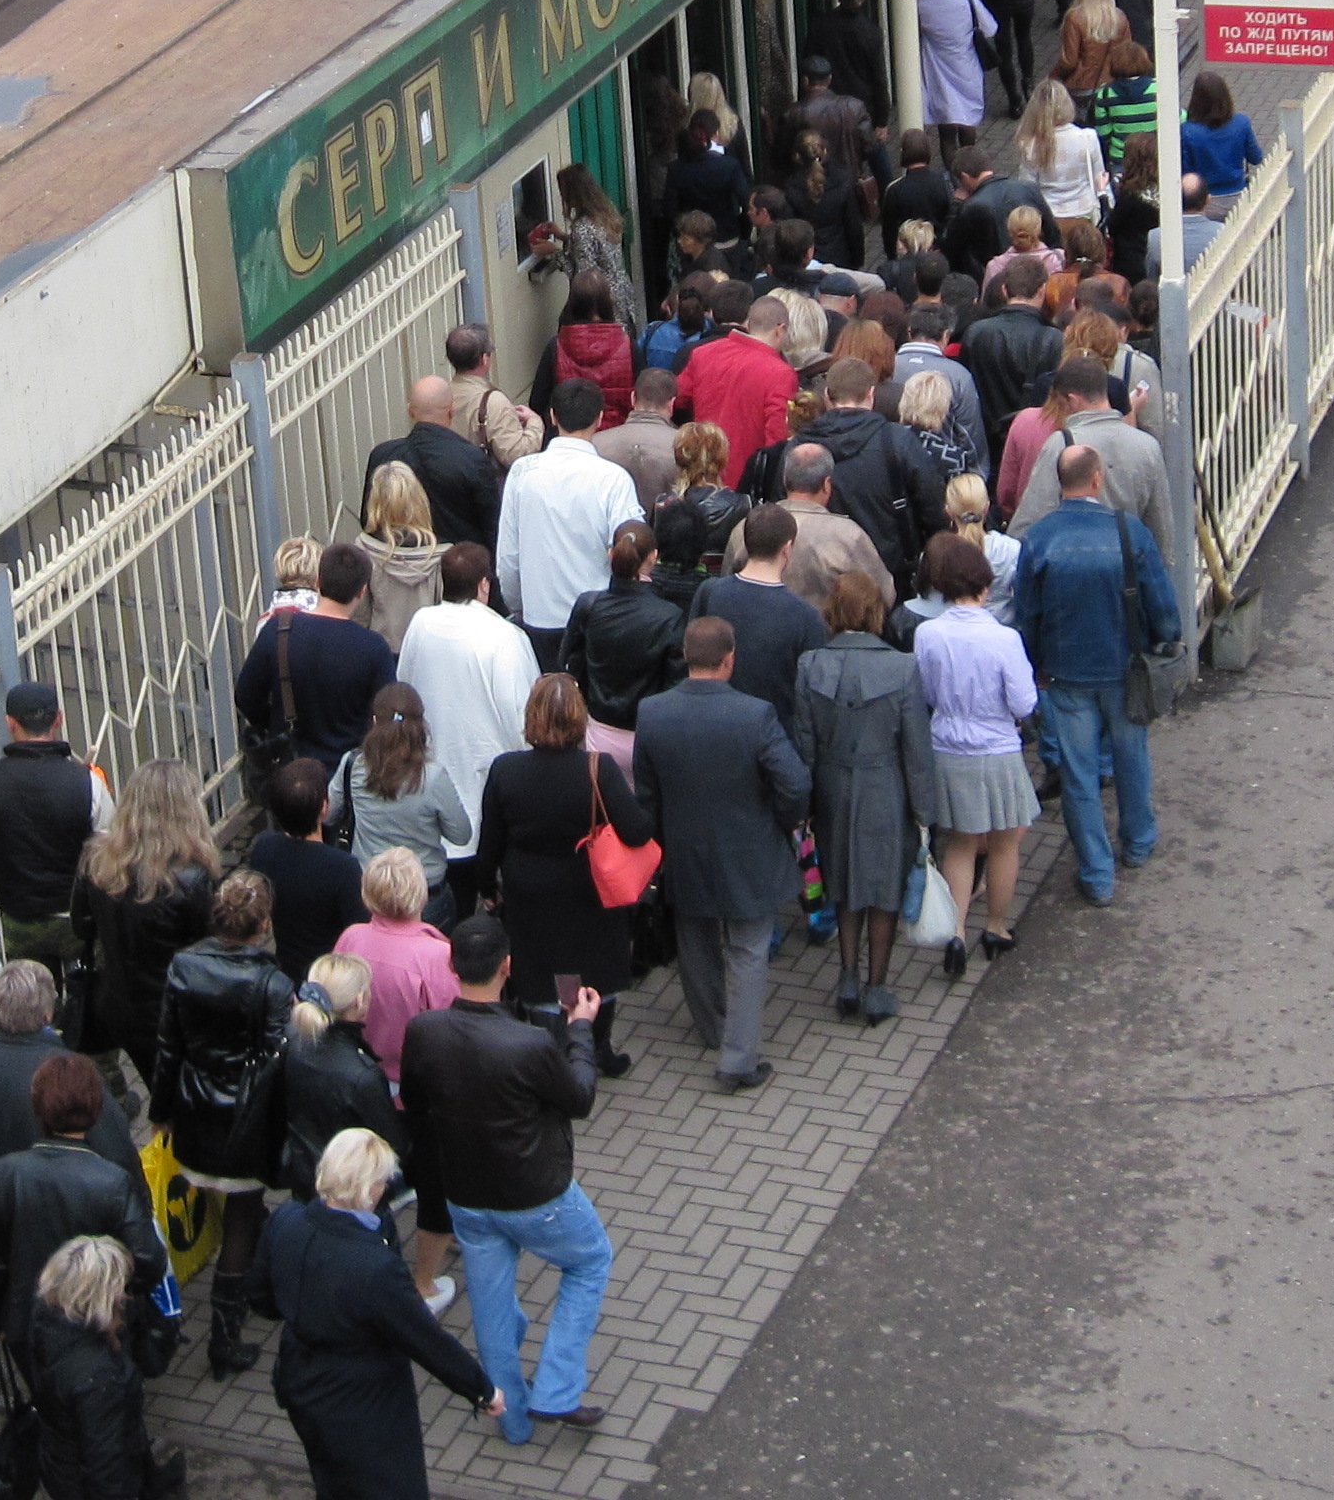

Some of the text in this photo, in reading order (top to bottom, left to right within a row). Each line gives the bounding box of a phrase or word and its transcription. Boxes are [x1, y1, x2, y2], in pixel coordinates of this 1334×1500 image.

[1244, 11, 1308, 25] ХОДИТЬ
[1219, 26, 1334, 42] ПО Ж/Д ПУТЯМ
[1225, 42, 1328, 57] ЗАПРЕЩЕНО!
[277, 57, 449, 279] СЕРП
[471, 8, 515, 127] И
